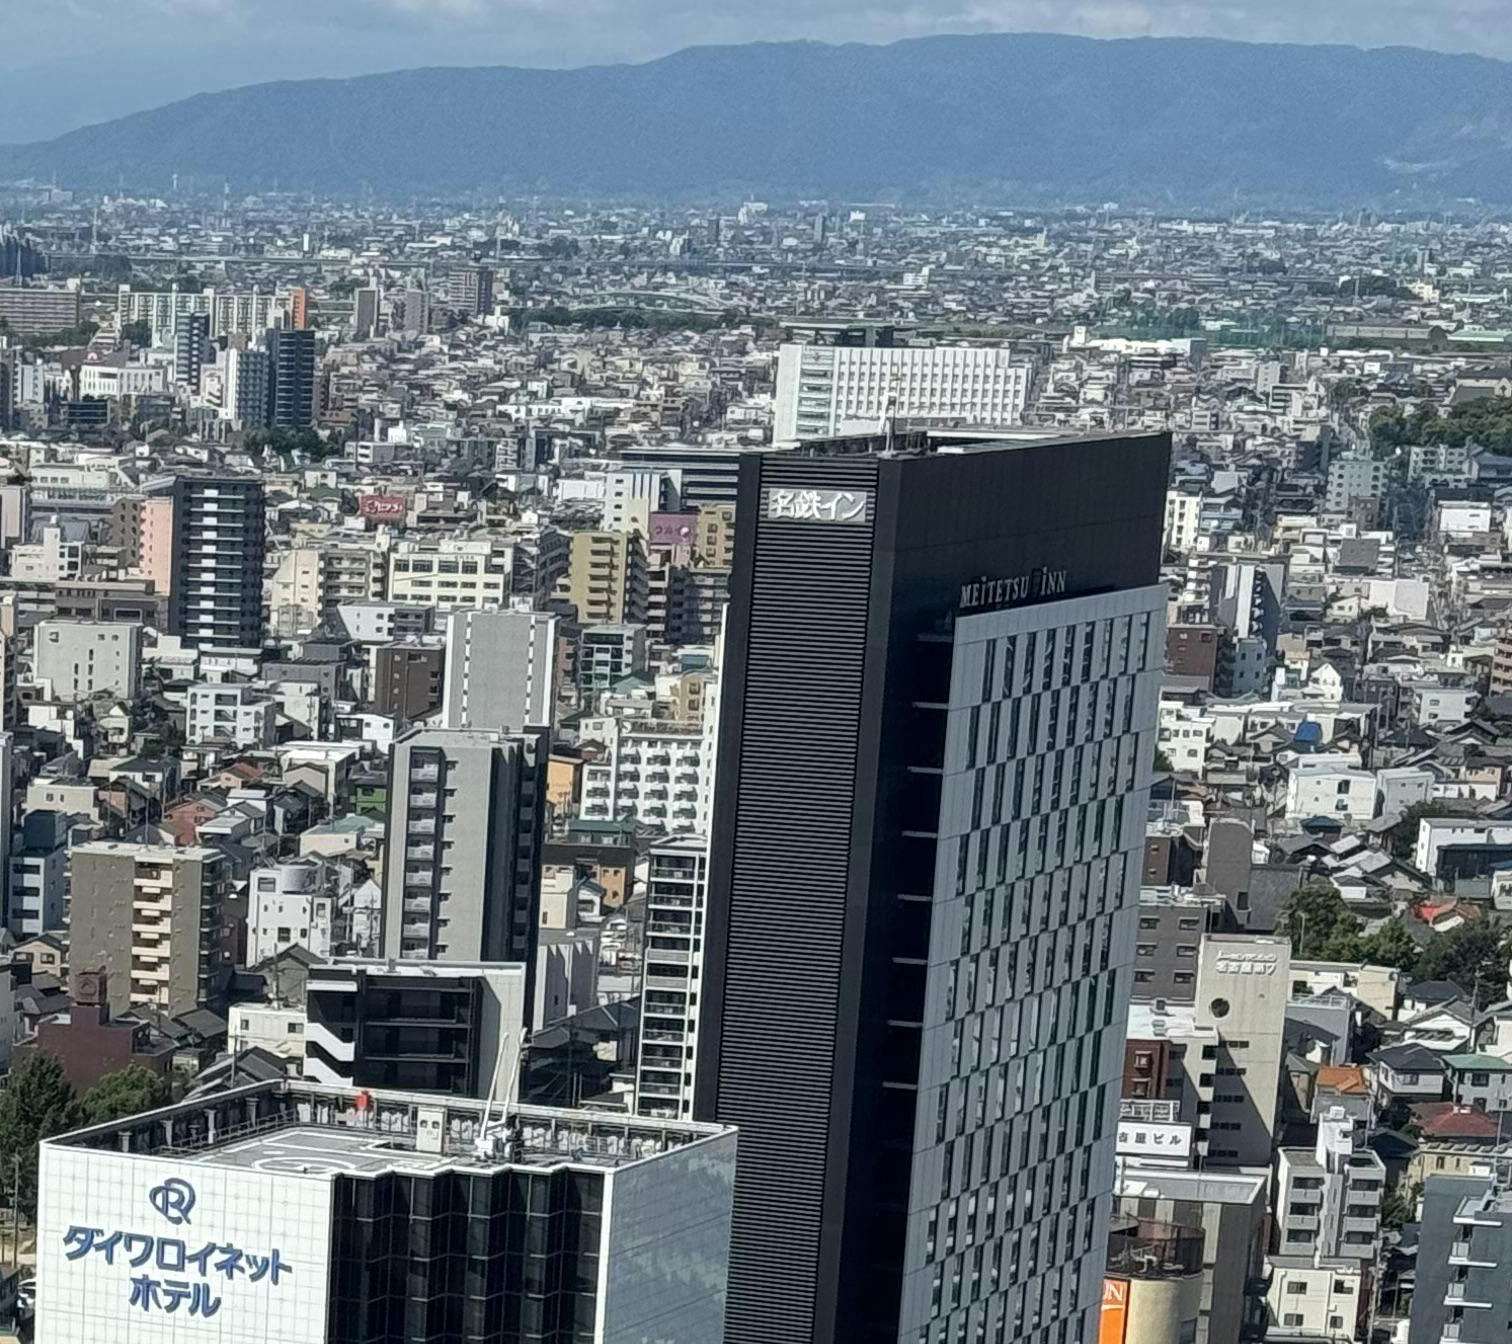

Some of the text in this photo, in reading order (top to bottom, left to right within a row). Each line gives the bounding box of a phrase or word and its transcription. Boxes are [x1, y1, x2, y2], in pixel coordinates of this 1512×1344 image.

[771, 489, 865, 519] 名鉄イン
[63, 1225, 292, 1286] ダイワロイネット
[129, 1274, 221, 1318] ホテル
